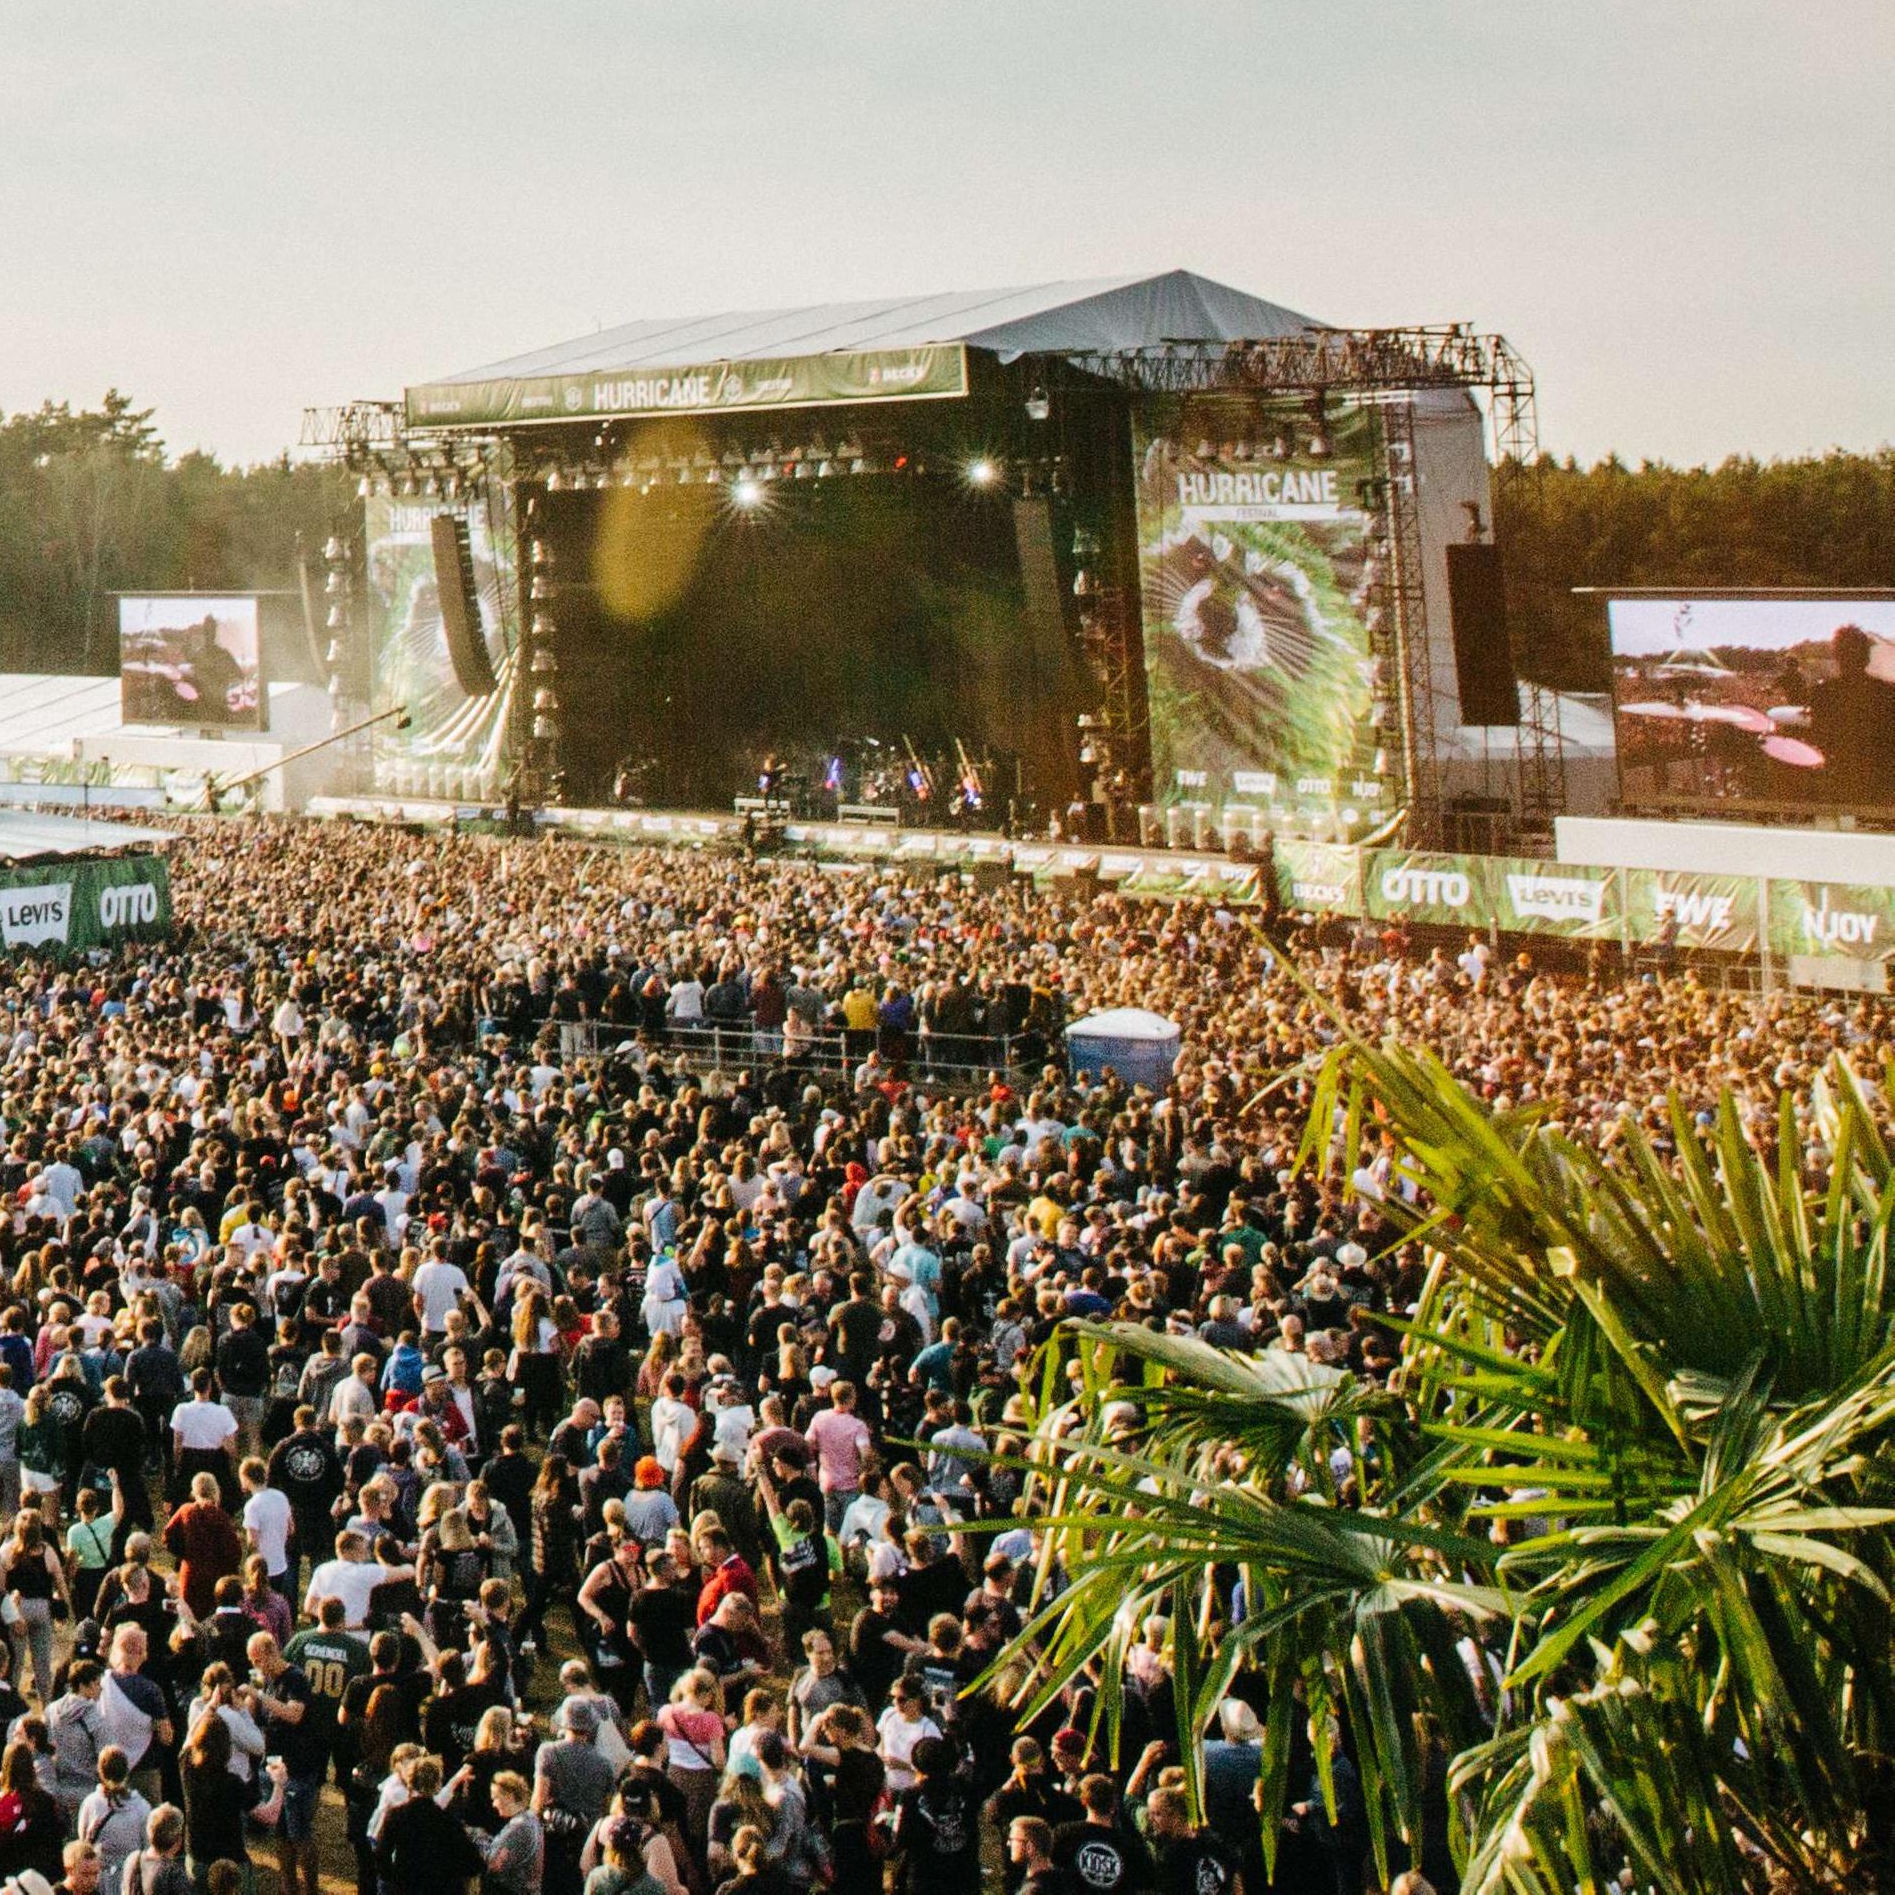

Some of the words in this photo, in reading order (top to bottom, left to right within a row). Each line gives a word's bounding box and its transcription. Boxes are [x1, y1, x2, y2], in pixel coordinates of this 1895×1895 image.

[594, 375, 710, 410] HURRICANE
[1178, 470, 1339, 504] HURRICANE
[1381, 869, 1470, 906] OTTO
[1520, 888, 1593, 908] Levi's
[8, 900, 63, 928] Levi's
[100, 882, 158, 928] OTTO
[1655, 892, 1732, 929] EWE
[1079, 1849, 1121, 1877] KIOSK
